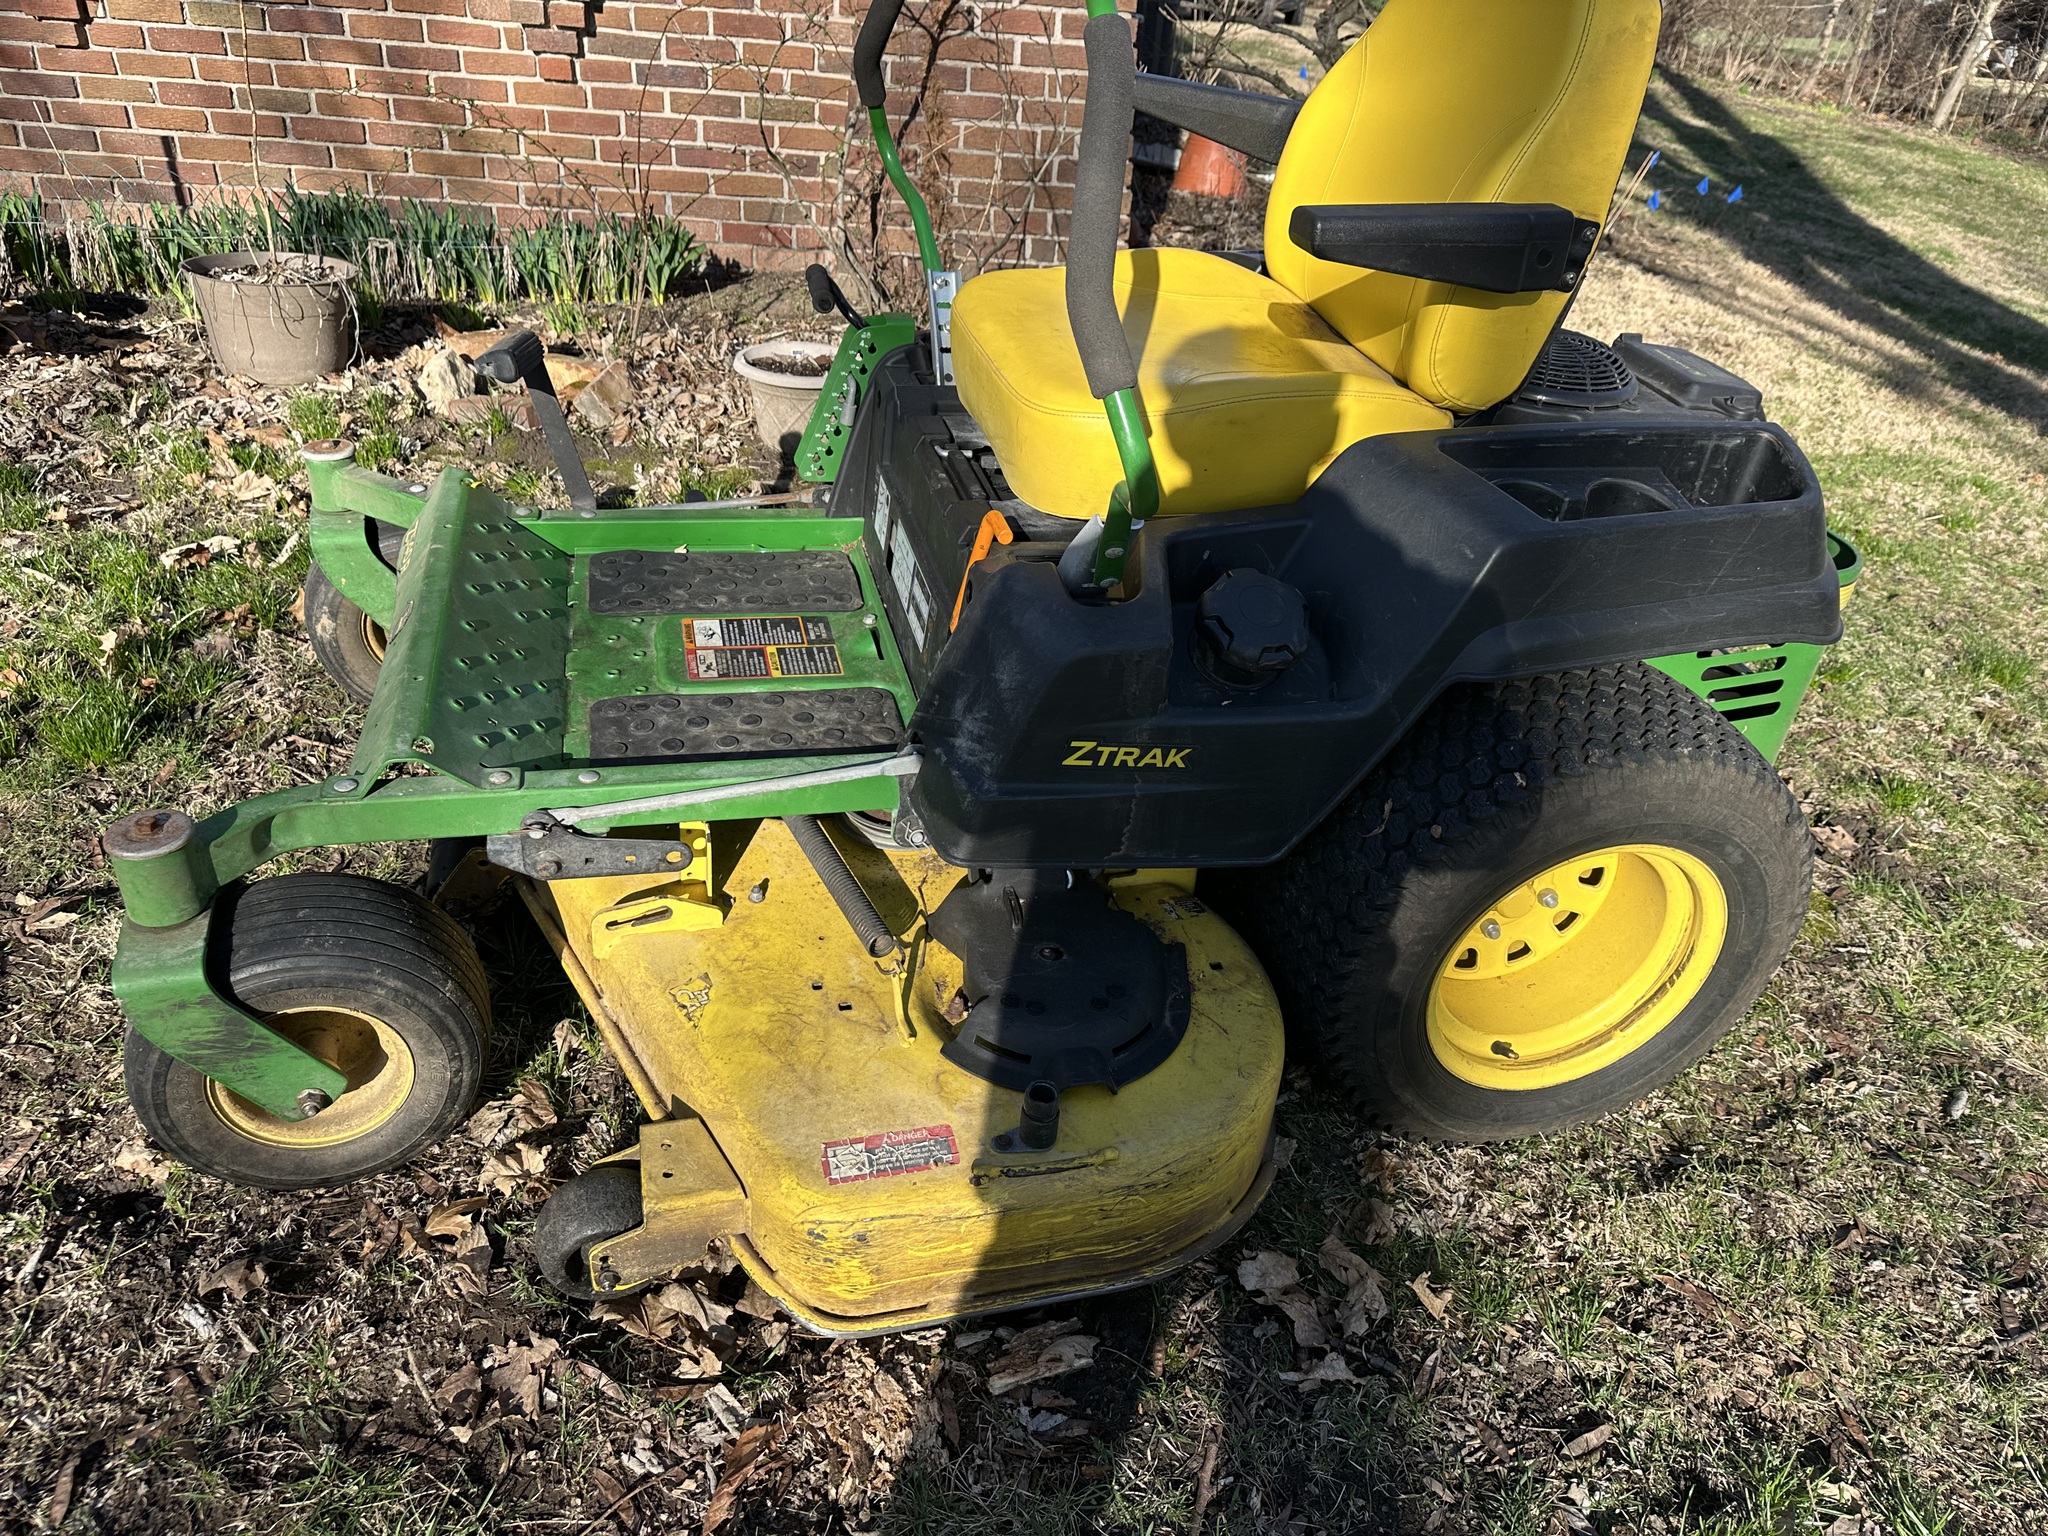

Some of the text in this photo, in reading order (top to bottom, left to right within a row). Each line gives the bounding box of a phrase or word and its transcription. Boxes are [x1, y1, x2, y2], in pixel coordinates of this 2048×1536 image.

[859, 339, 864, 347] 4
[842, 382, 847, 391] 3
[1061, 741, 1193, 768] ZTRAK
[418, 1059, 447, 1119] KENDA
[891, 1129, 929, 1142] DANGER
